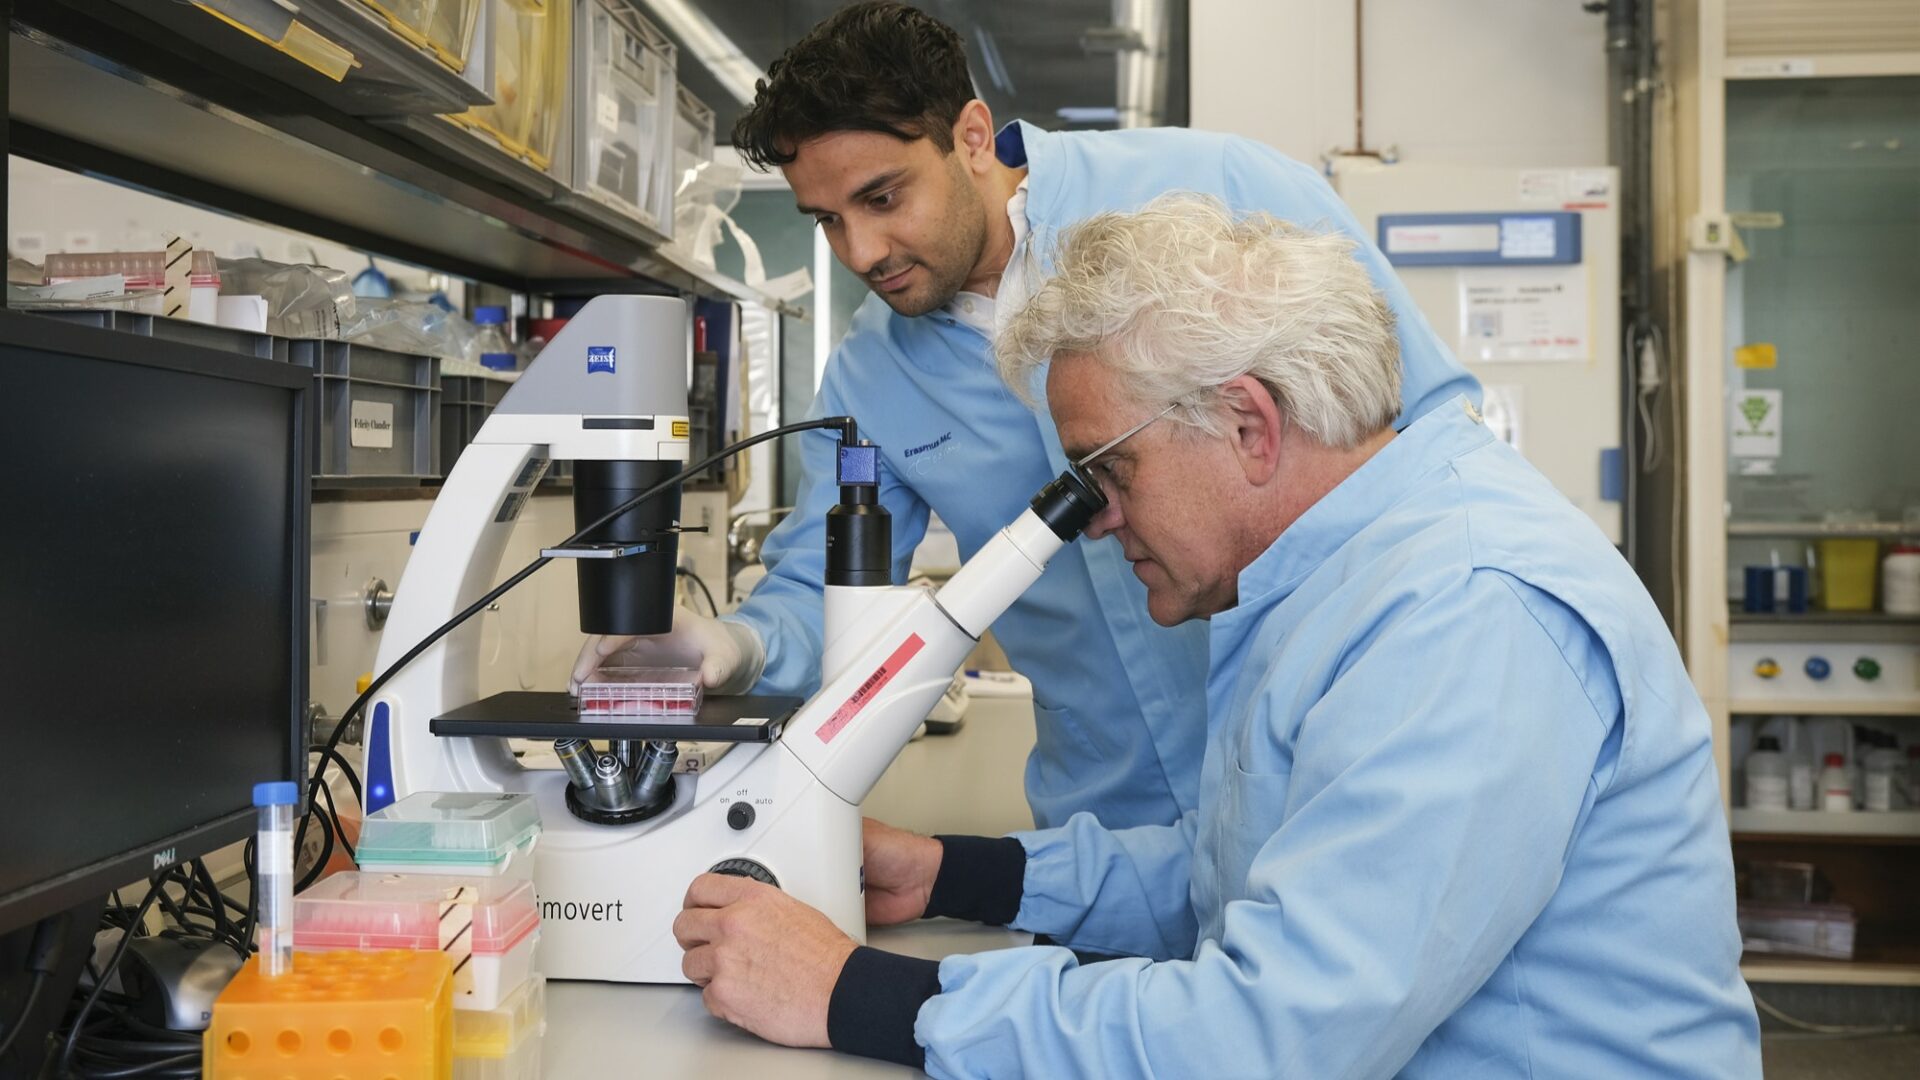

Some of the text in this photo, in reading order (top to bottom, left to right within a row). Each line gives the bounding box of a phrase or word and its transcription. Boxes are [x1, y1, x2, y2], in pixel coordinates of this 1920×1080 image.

[904, 431, 952, 458] Erasmus MC
[736, 788, 748, 796] off
[755, 797, 773, 805] auto
[153, 847, 176, 870] DELL
